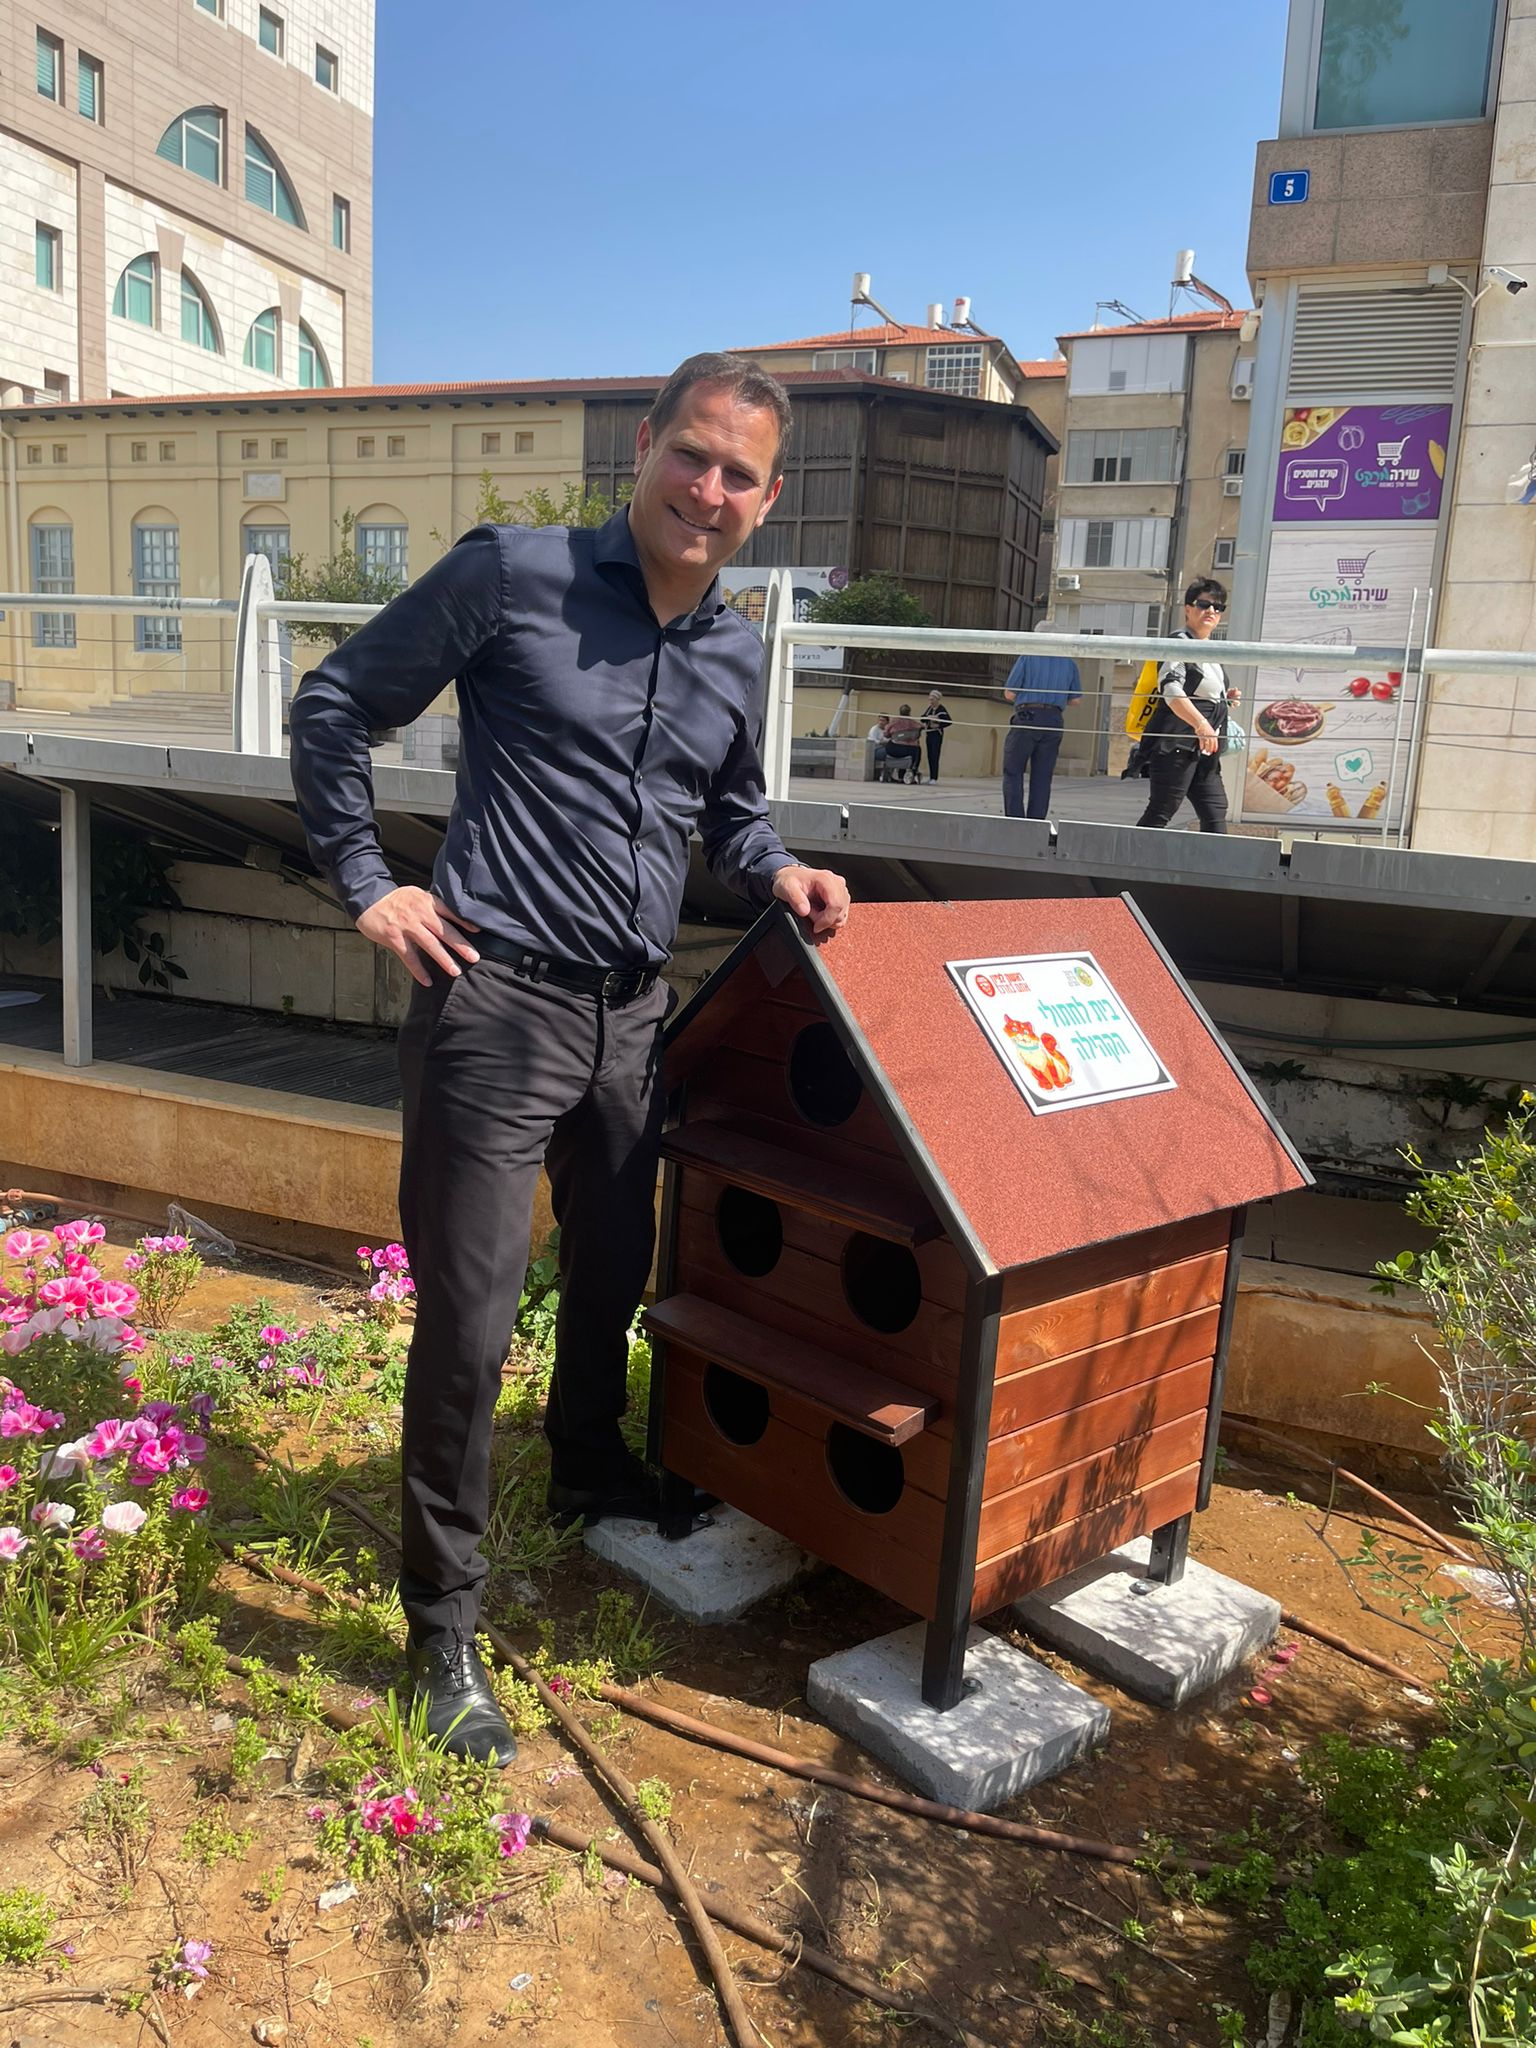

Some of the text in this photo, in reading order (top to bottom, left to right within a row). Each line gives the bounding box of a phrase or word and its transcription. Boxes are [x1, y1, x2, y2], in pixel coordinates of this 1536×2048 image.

[1284, 178, 1295, 197] 5
[1319, 469, 1338, 479] קונים
[1037, 996, 1120, 1027] בית לחתולי
[1071, 1030, 1131, 1063] הקהילה
